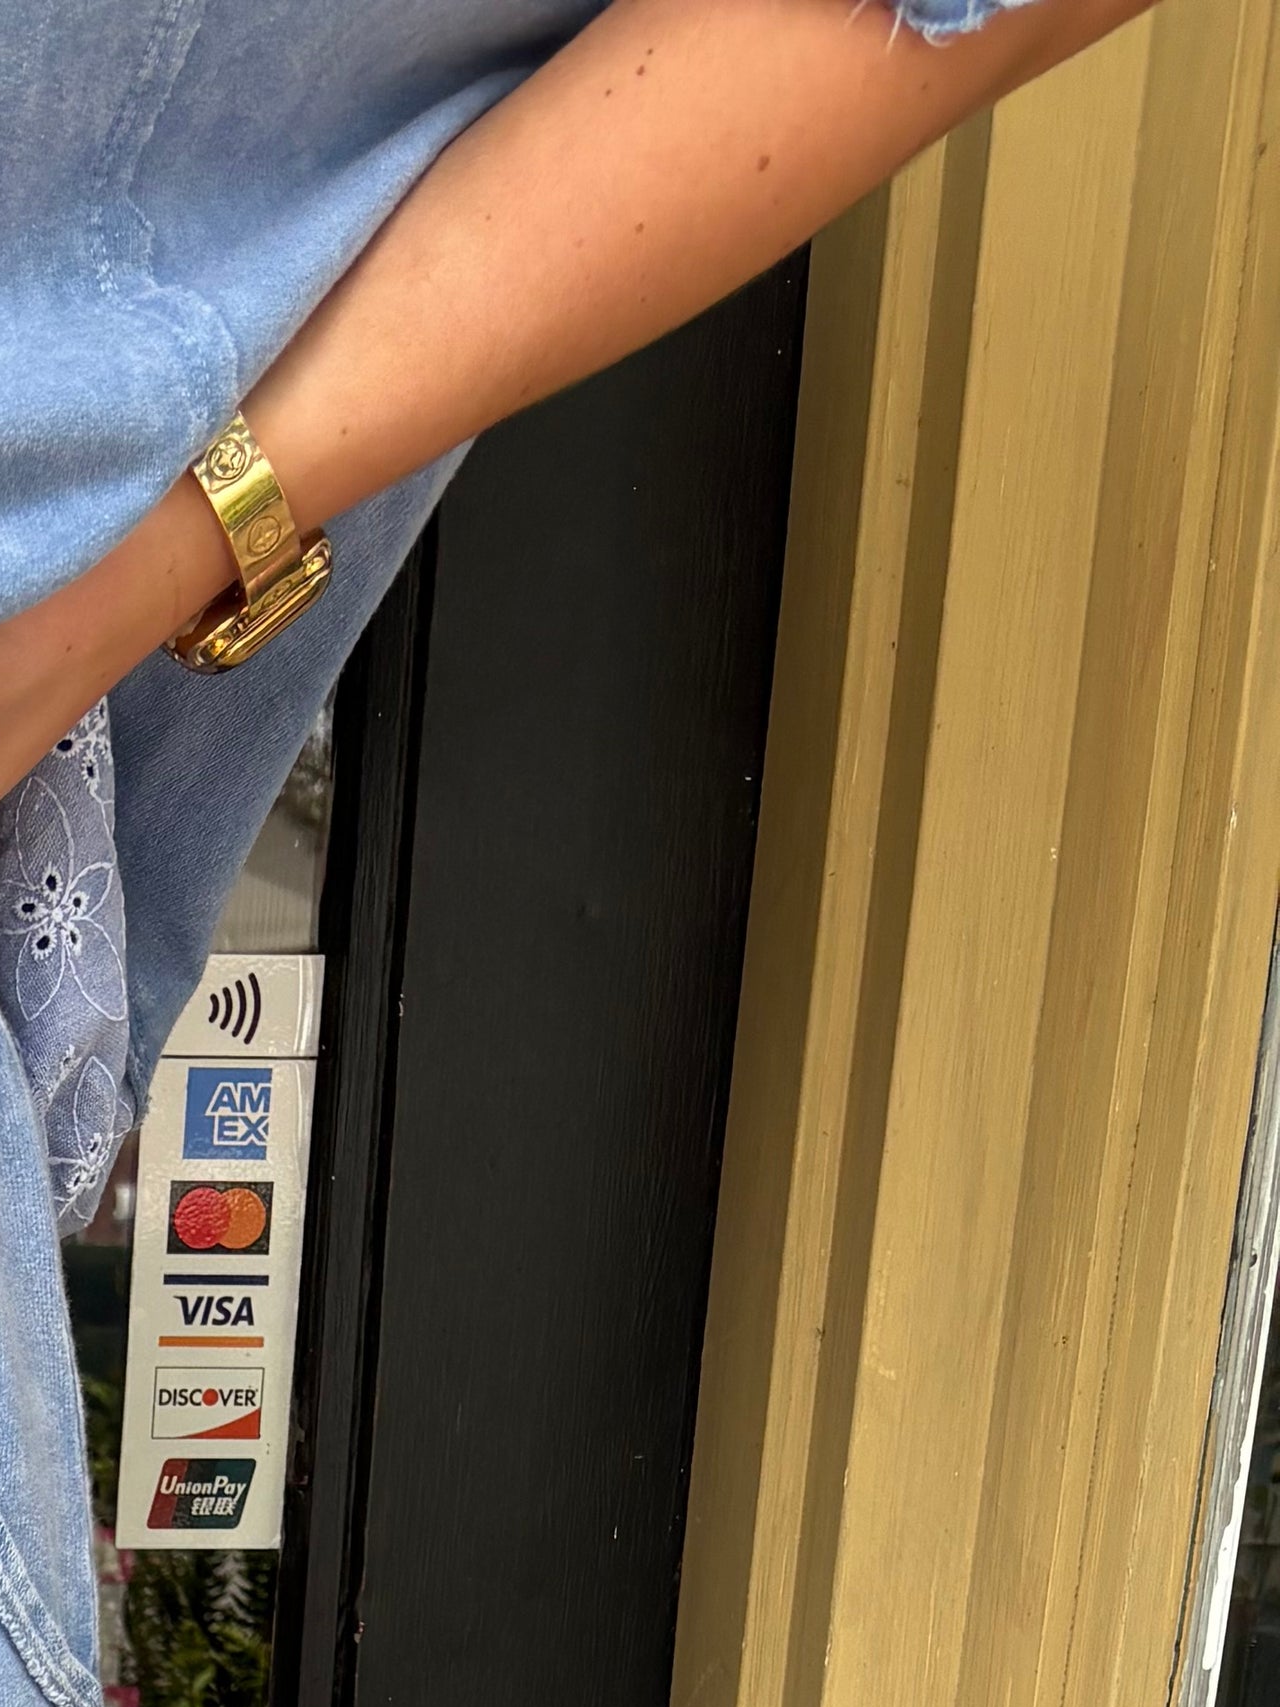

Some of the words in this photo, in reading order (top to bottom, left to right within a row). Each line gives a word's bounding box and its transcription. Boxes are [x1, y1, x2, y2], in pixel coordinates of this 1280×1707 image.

[205, 1082, 273, 1116] AM
[213, 1114, 271, 1146] EX
[173, 1295, 255, 1327] VISA
[158, 1387, 257, 1407] DISCOVER
[160, 1475, 246, 1501] UnionPay
